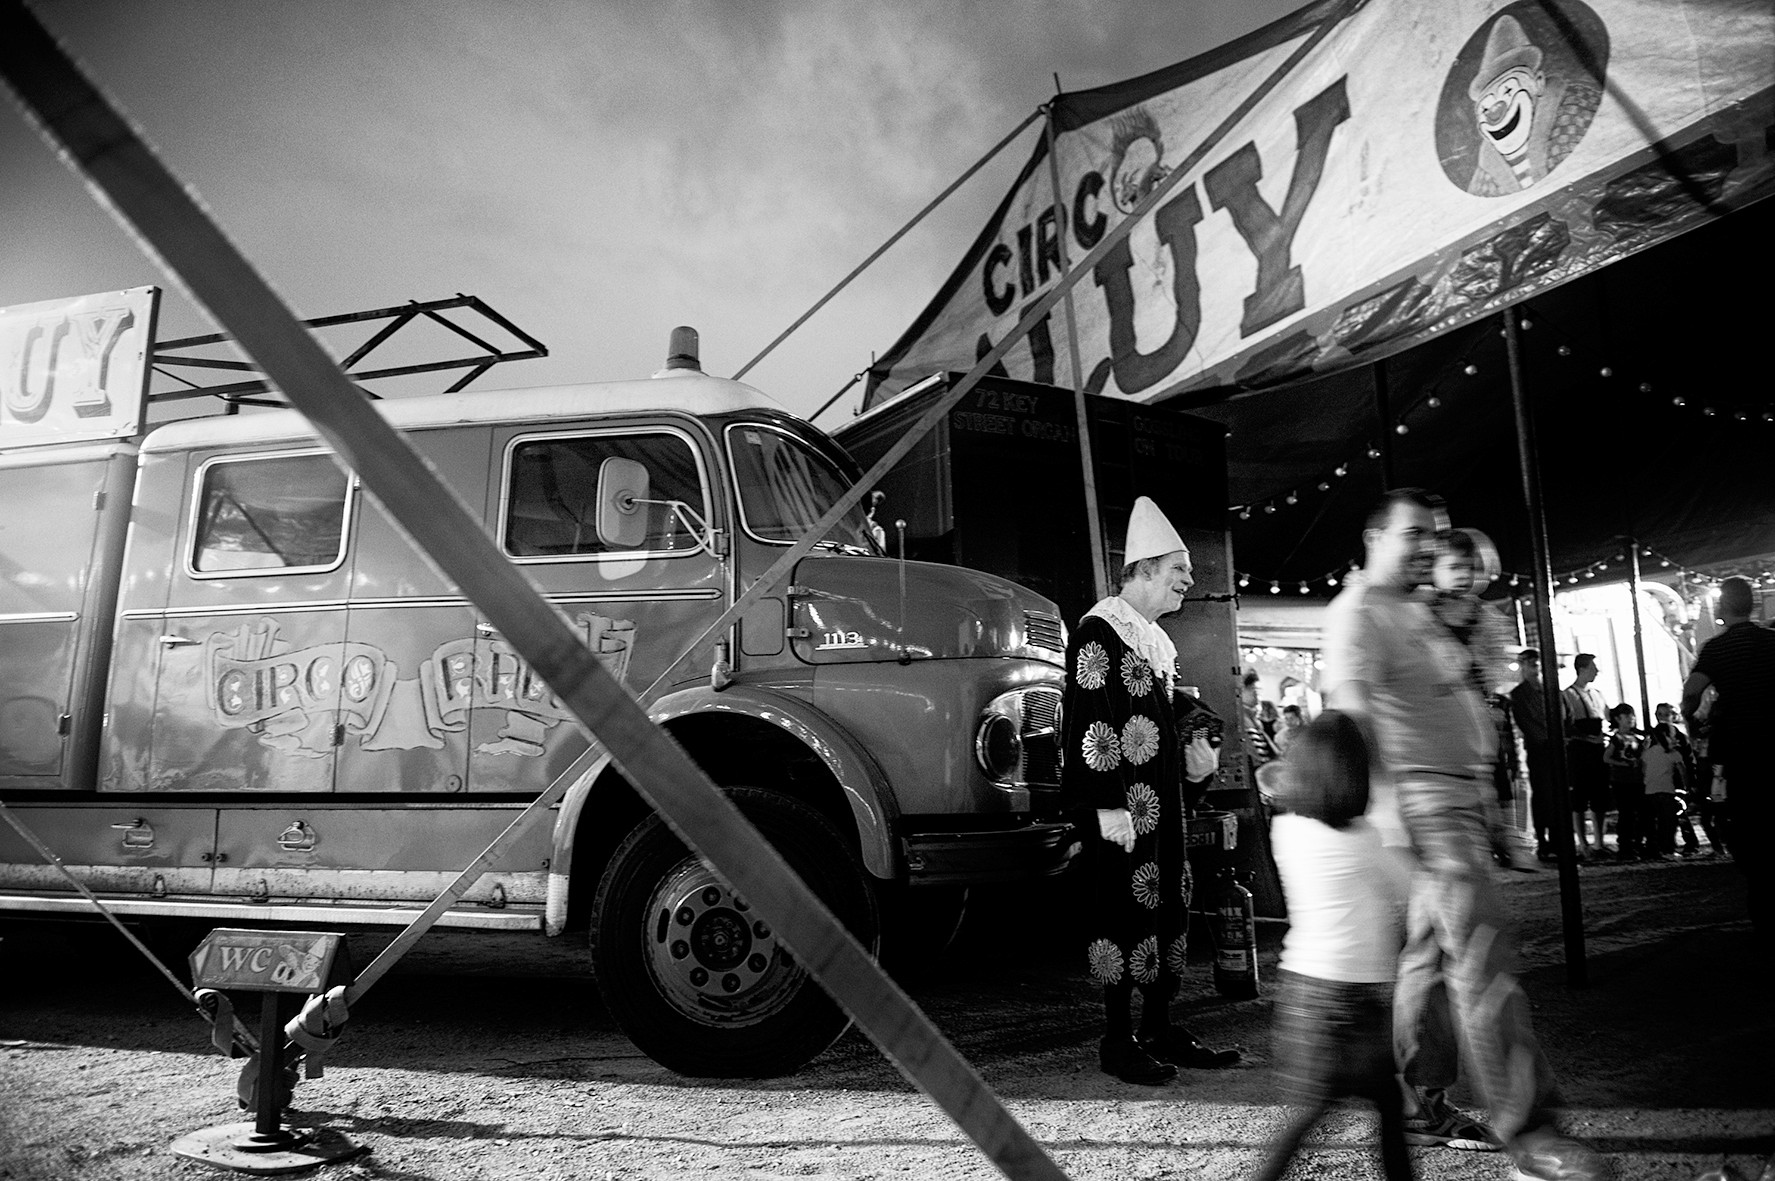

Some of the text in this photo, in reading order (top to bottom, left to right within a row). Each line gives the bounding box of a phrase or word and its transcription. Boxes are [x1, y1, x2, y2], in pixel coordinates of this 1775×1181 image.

[974, 388, 1039, 414] 72 KEY
[953, 411, 1016, 435] STREET
[217, 653, 376, 715] CIRCO
[220, 946, 273, 973] WC
